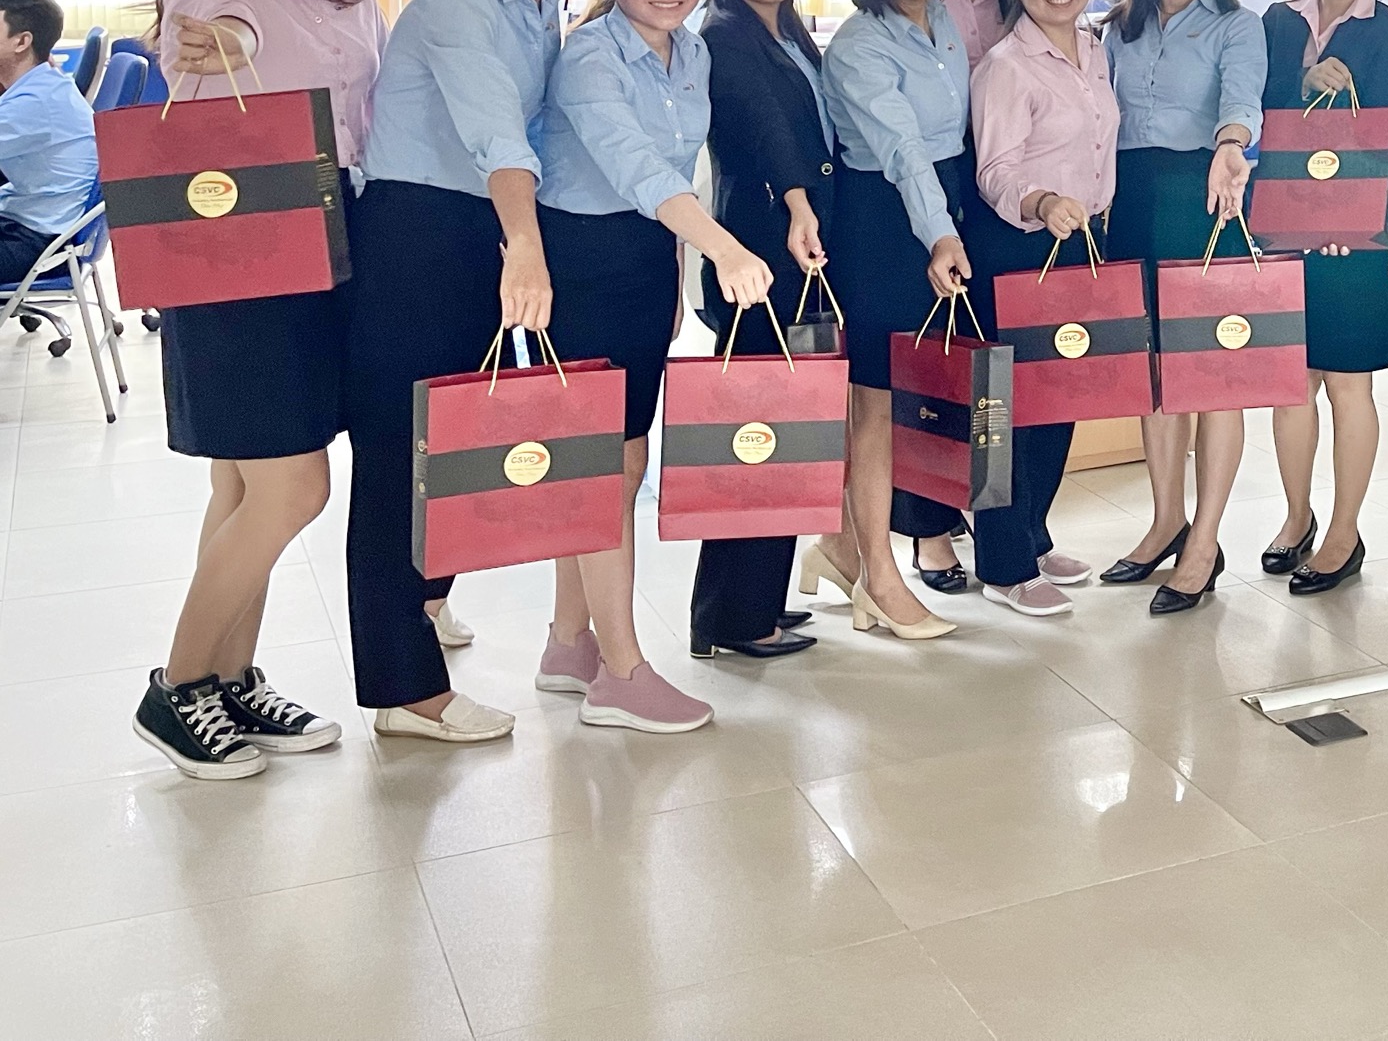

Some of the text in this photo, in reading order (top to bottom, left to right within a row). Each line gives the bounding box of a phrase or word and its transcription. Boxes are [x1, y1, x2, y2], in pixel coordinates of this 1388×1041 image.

[193, 186, 221, 194] CSVC
[1059, 334, 1079, 342] CSVC
[739, 435, 763, 443] CSVC
[511, 456, 536, 464] CSVC
